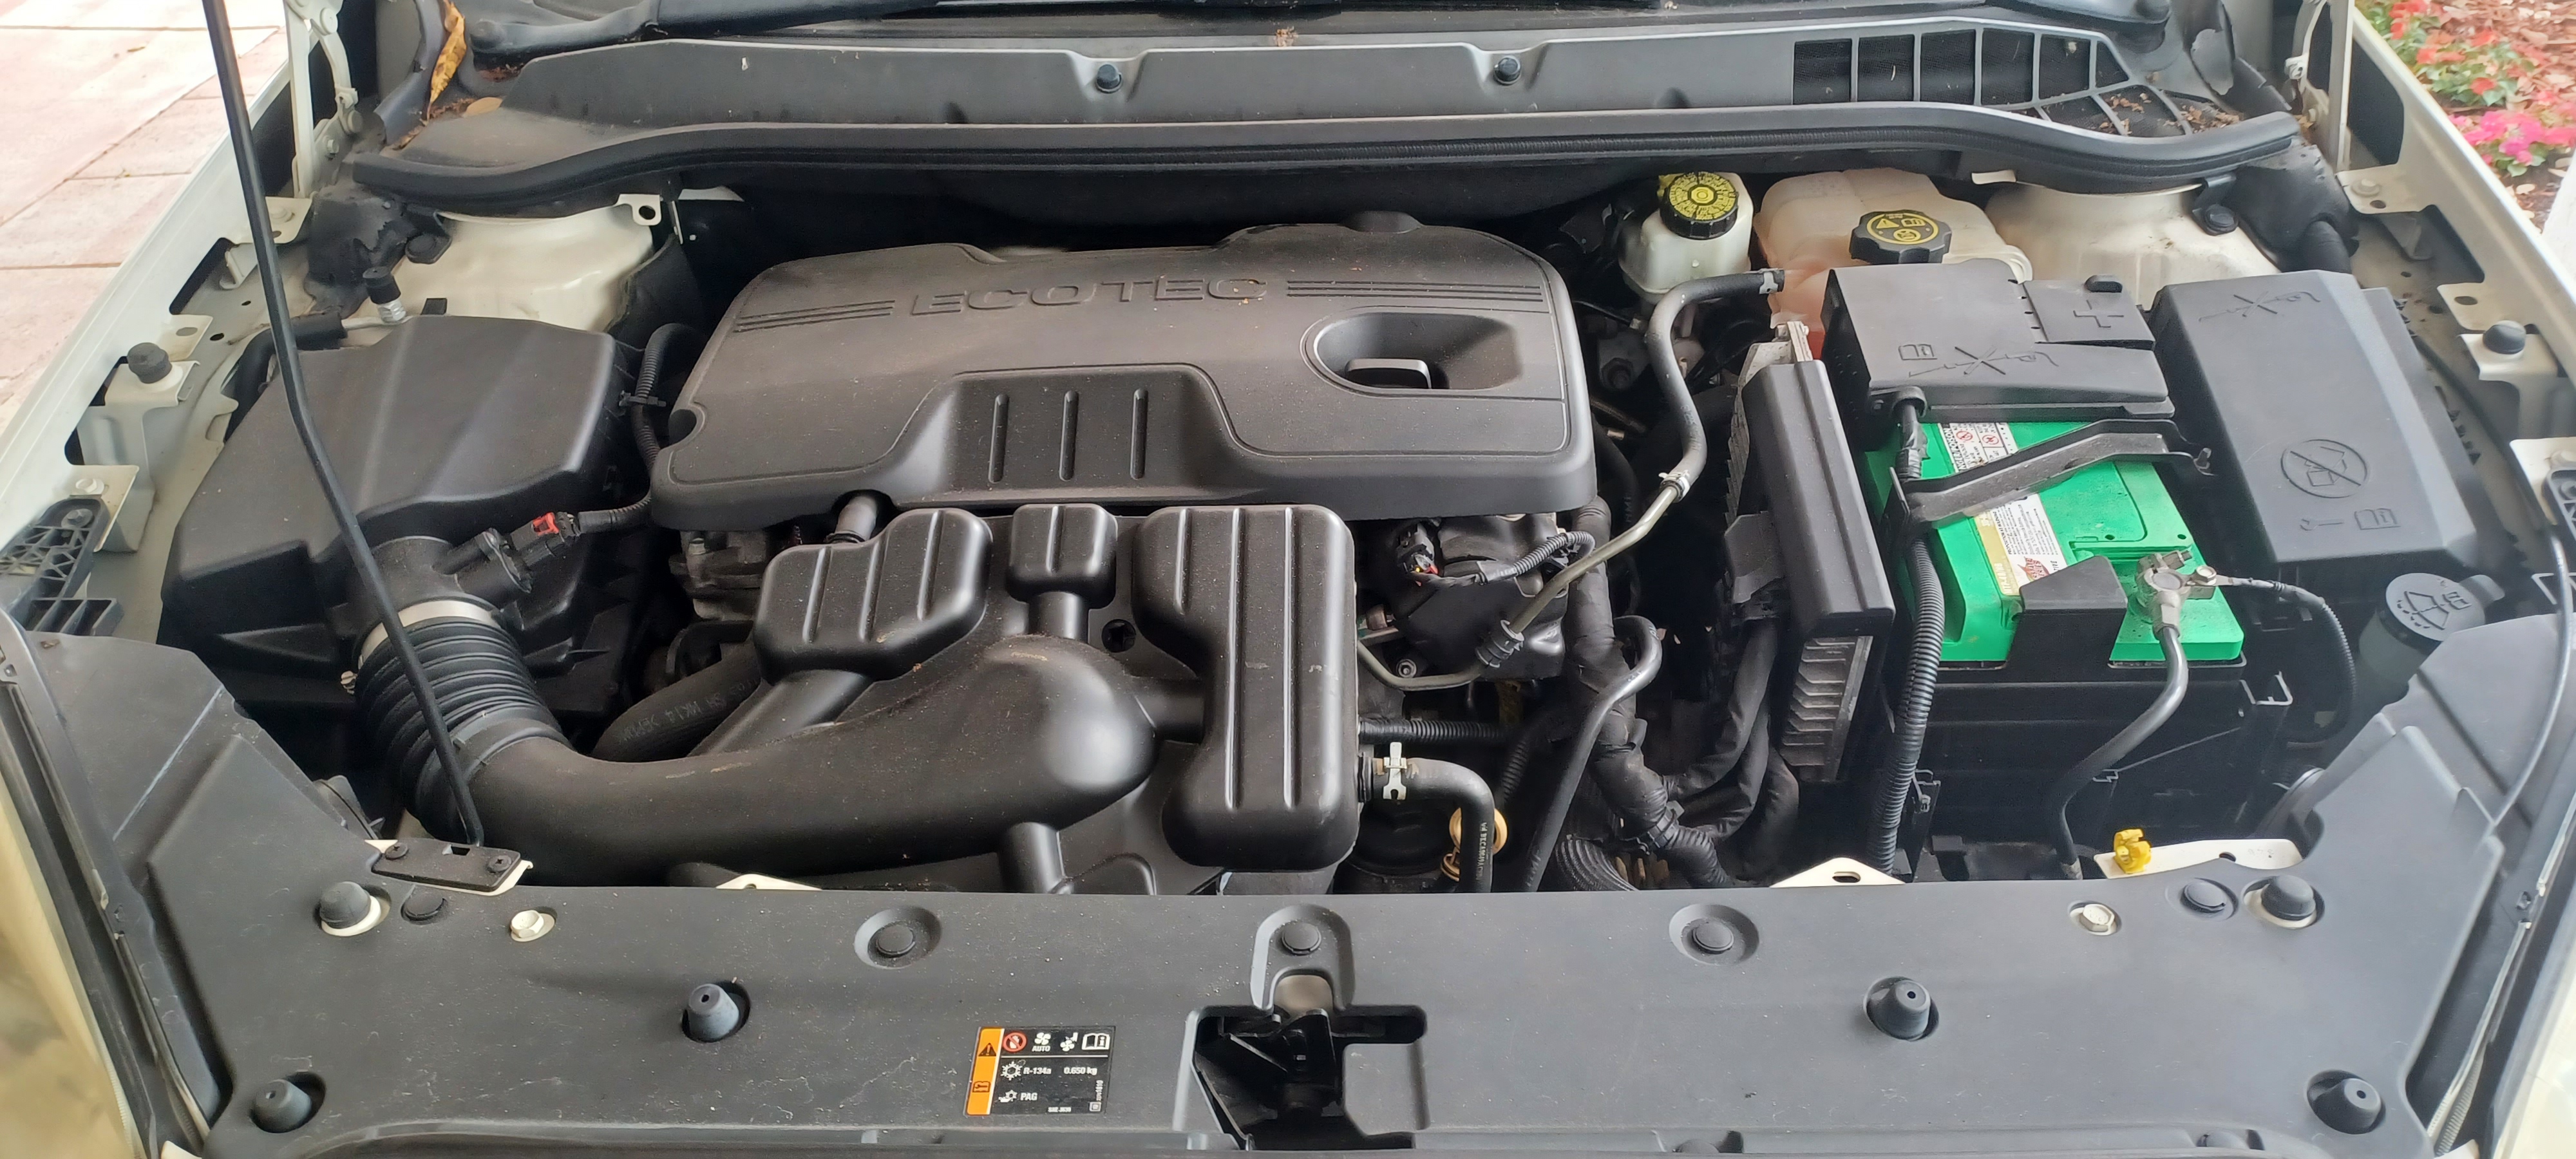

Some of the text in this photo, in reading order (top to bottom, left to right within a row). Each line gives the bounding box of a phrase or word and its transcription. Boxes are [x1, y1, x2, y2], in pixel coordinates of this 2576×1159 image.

[909, 277, 1269, 317] ECOTEC
[1944, 428, 1967, 469] NGER/POISON
[1023, 1066, 1097, 1076] R-134a 0.650 kg
[1020, 1093, 1037, 1102] PAG
